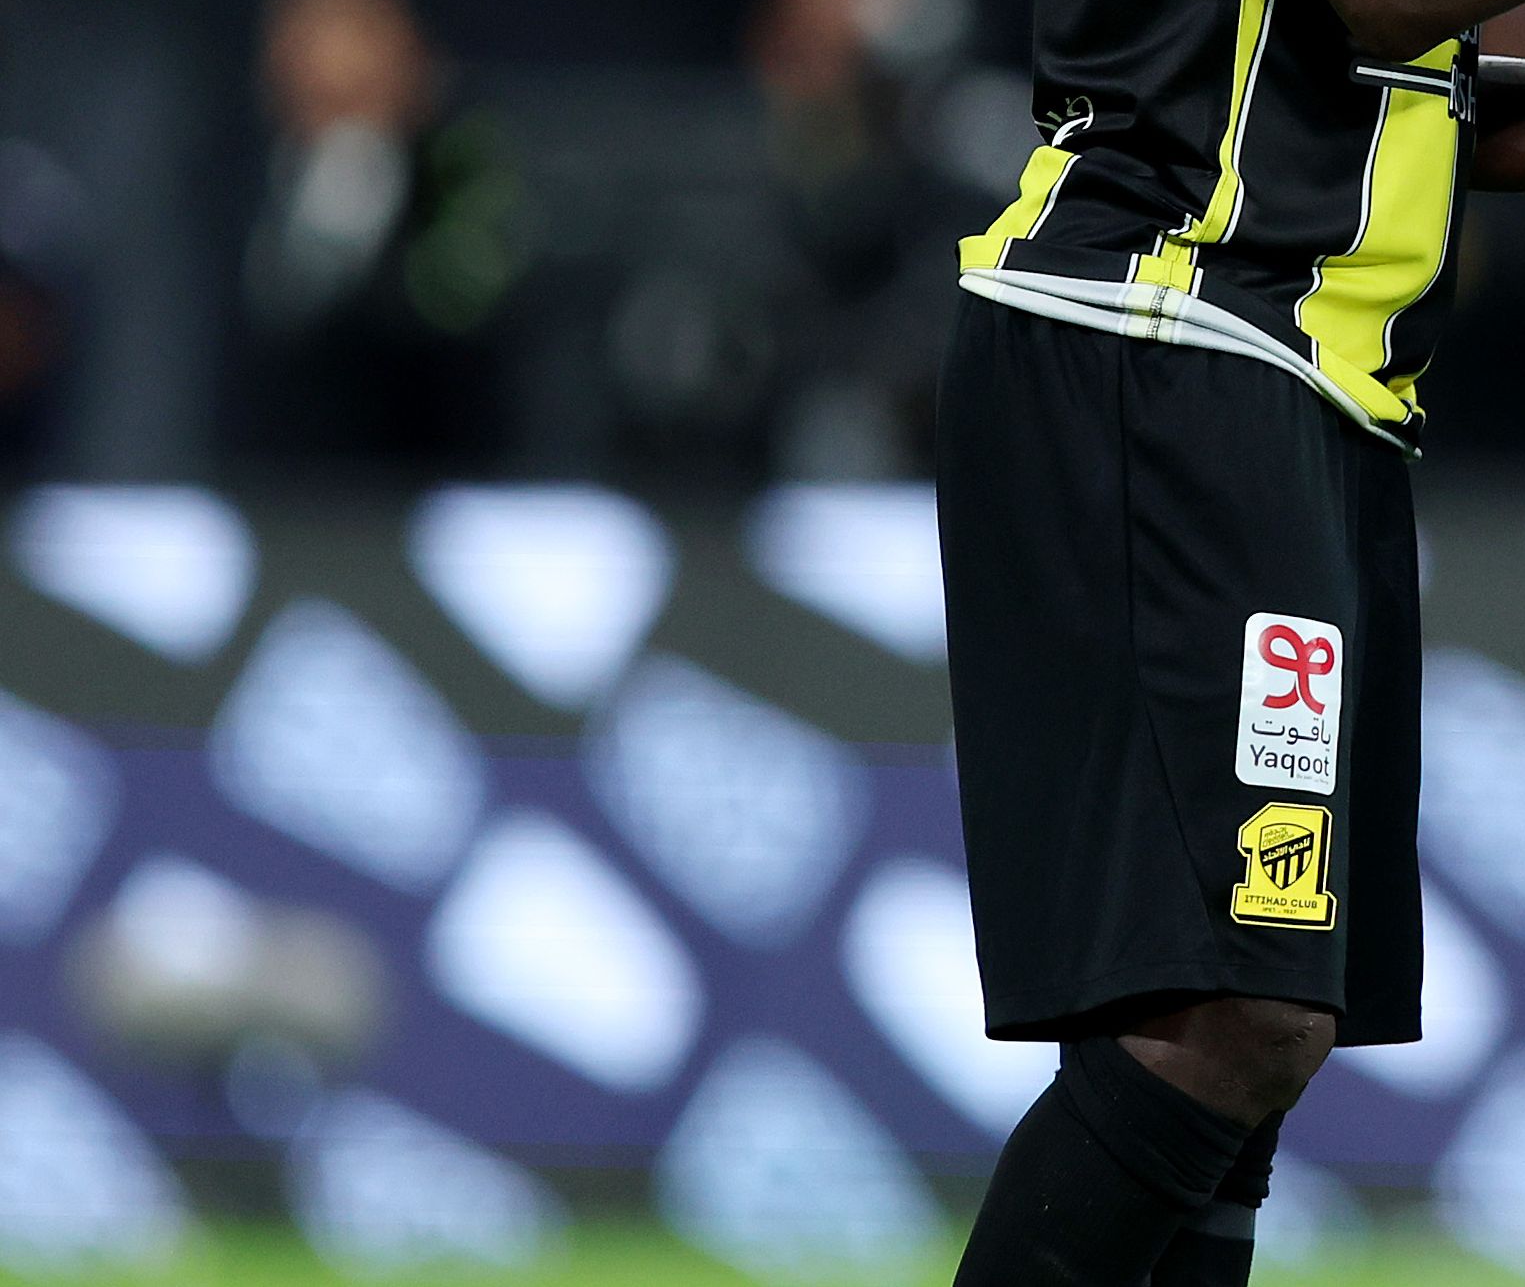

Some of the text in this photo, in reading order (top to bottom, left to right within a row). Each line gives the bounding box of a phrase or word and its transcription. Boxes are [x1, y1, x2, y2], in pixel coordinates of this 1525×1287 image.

[1251, 716, 1331, 753] ياقوت
[1250, 743, 1330, 779] Yaqoot
[1244, 894, 1318, 909] ITTIHAD CLUB
